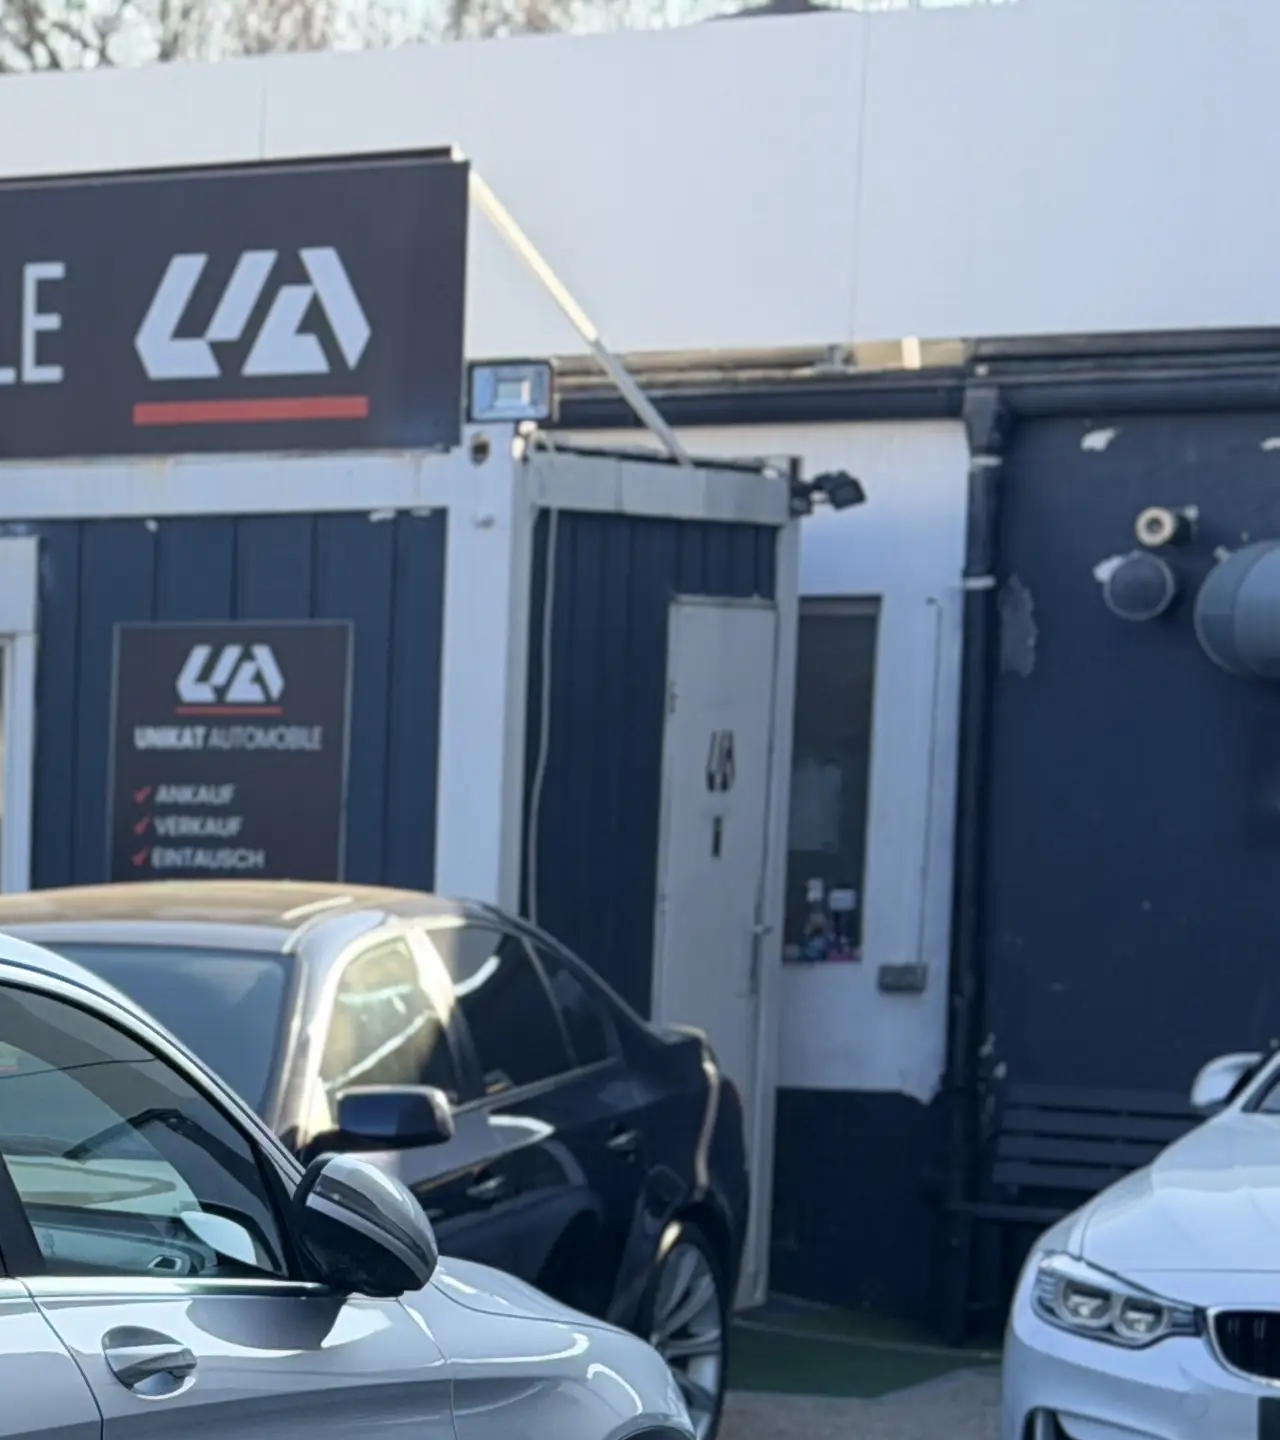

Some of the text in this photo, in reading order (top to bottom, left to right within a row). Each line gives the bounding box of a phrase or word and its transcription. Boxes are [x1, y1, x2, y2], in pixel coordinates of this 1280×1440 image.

[134, 725, 324, 751] UNIKAT AUTOMOBILE
[155, 784, 236, 805] ANKAUF
[154, 815, 244, 837] VERKAUF
[151, 847, 265, 870] EINTAUSCH
